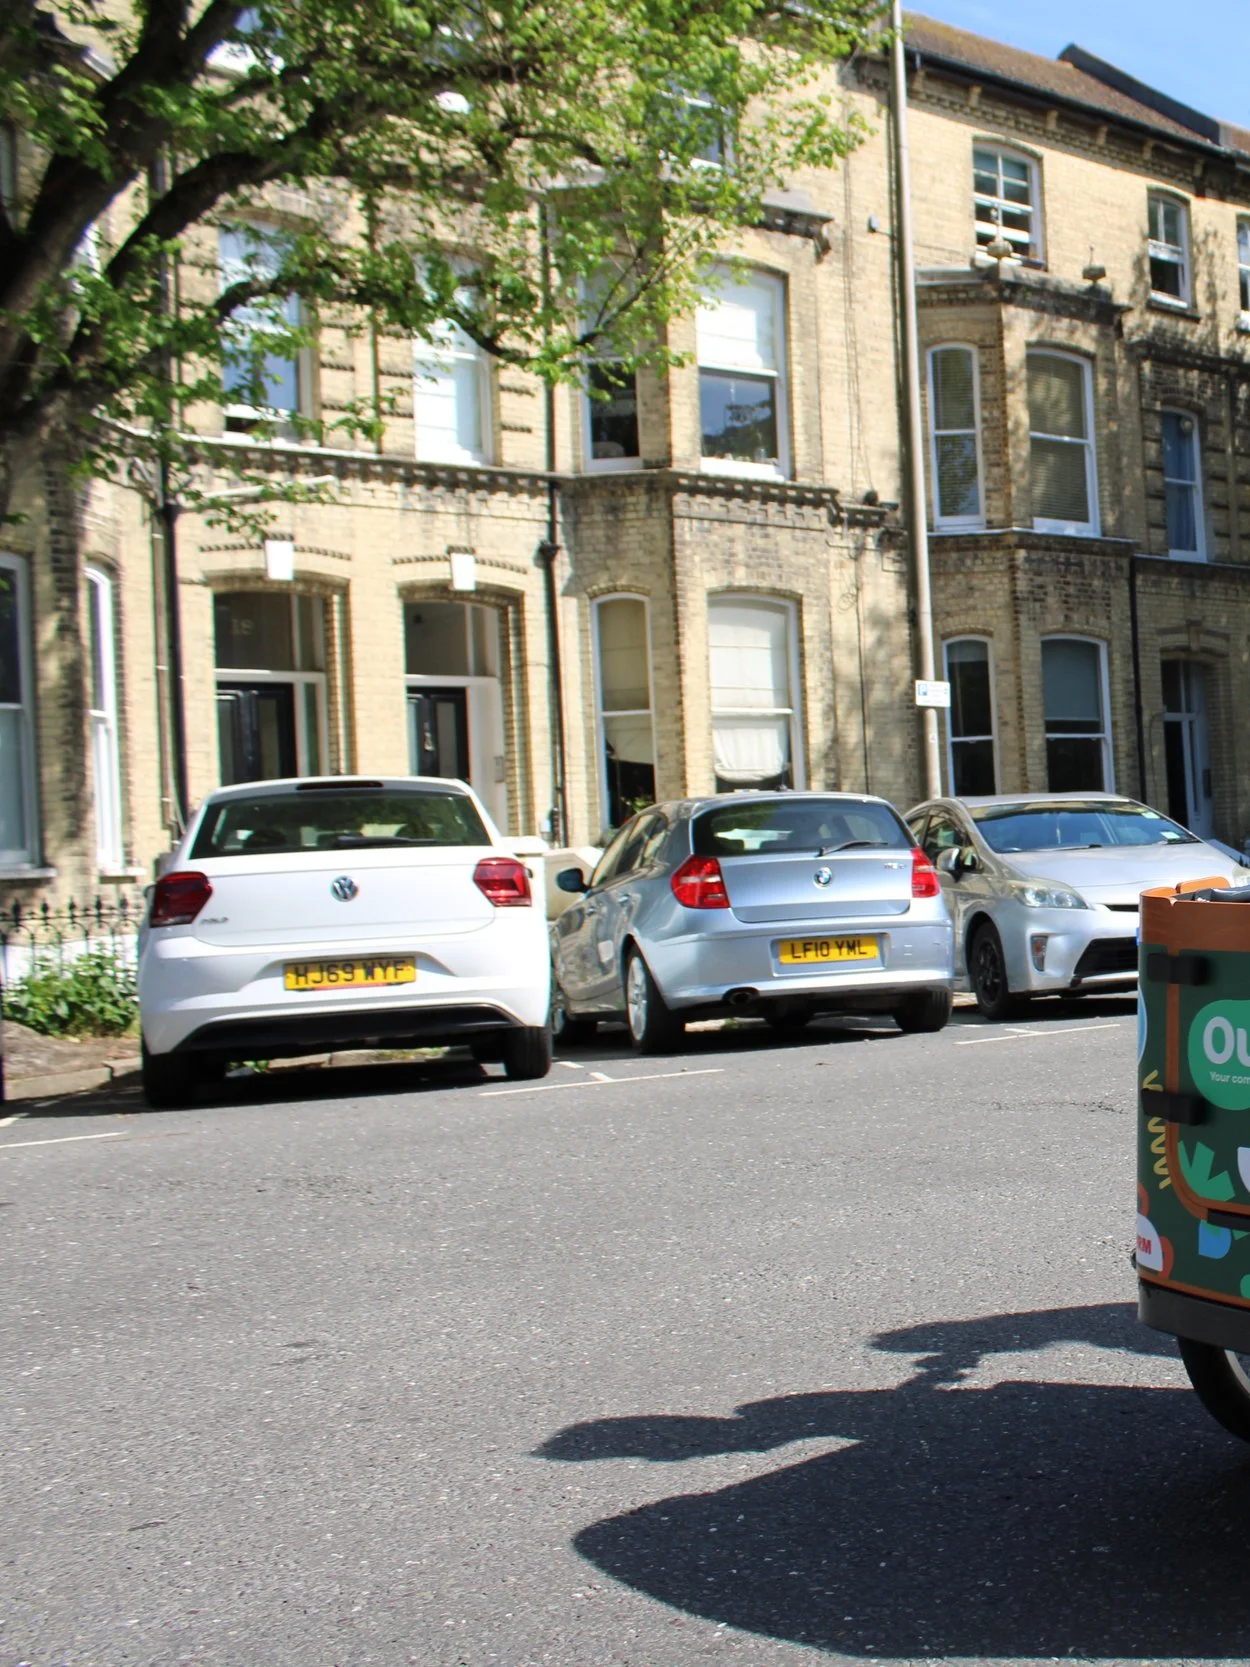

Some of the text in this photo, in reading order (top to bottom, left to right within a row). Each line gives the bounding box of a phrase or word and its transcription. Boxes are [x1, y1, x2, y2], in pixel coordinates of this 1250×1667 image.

[790, 939, 868, 959] LF10 YML
[293, 959, 406, 986] HJ69 WYF
[1209, 1071, 1229, 1082] Your
